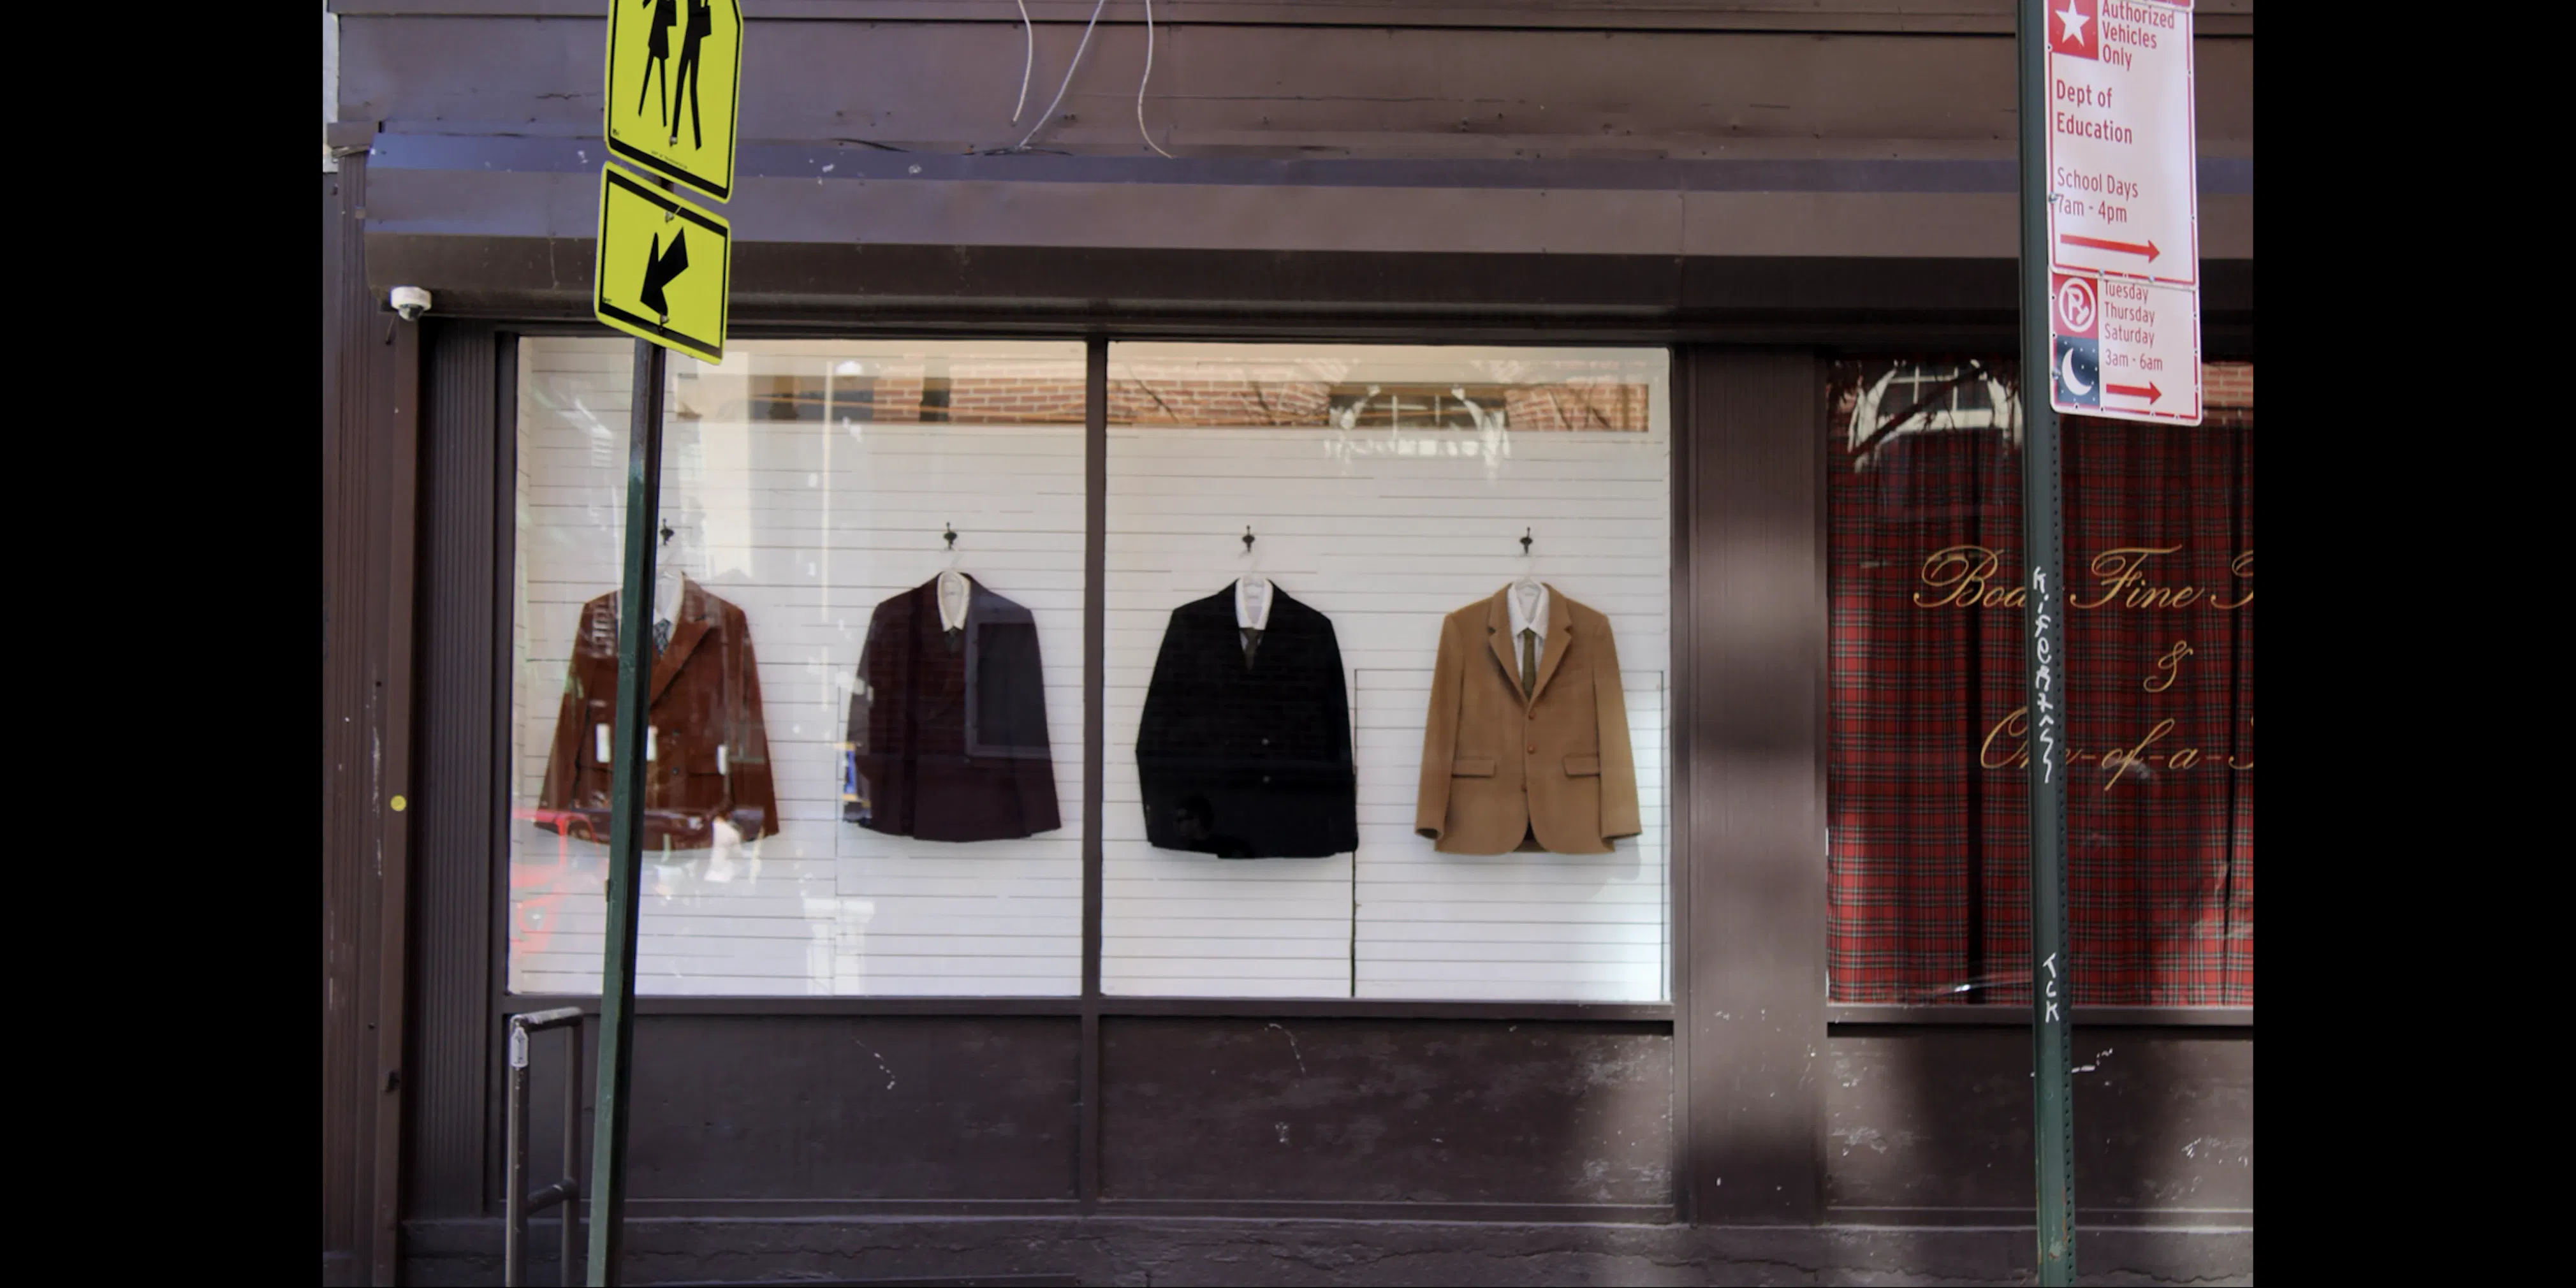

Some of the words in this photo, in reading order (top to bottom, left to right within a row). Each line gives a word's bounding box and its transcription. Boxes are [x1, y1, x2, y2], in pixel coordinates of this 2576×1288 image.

[2102, 0, 2174, 29] Authorized
[2102, 20, 2157, 49] Vehicles
[2103, 44, 2132, 71] Only
[2056, 79, 2091, 108] Dept
[2098, 88, 2112, 108] of
[2057, 112, 2132, 144] Education
[2058, 167, 2102, 192] School
[2107, 175, 2138, 201] Days
[2057, 193, 2084, 217] 7am
[2098, 201, 2127, 224] 4pm
[2105, 280, 2148, 304] Tuesday
[2105, 302, 2155, 327] Thursday
[2105, 323, 2155, 348] Saturday
[2105, 349, 2128, 367] 3am
[2140, 354, 2163, 372] 6am
[2070, 544, 2204, 608] Fine
[2143, 640, 2193, 692] &
